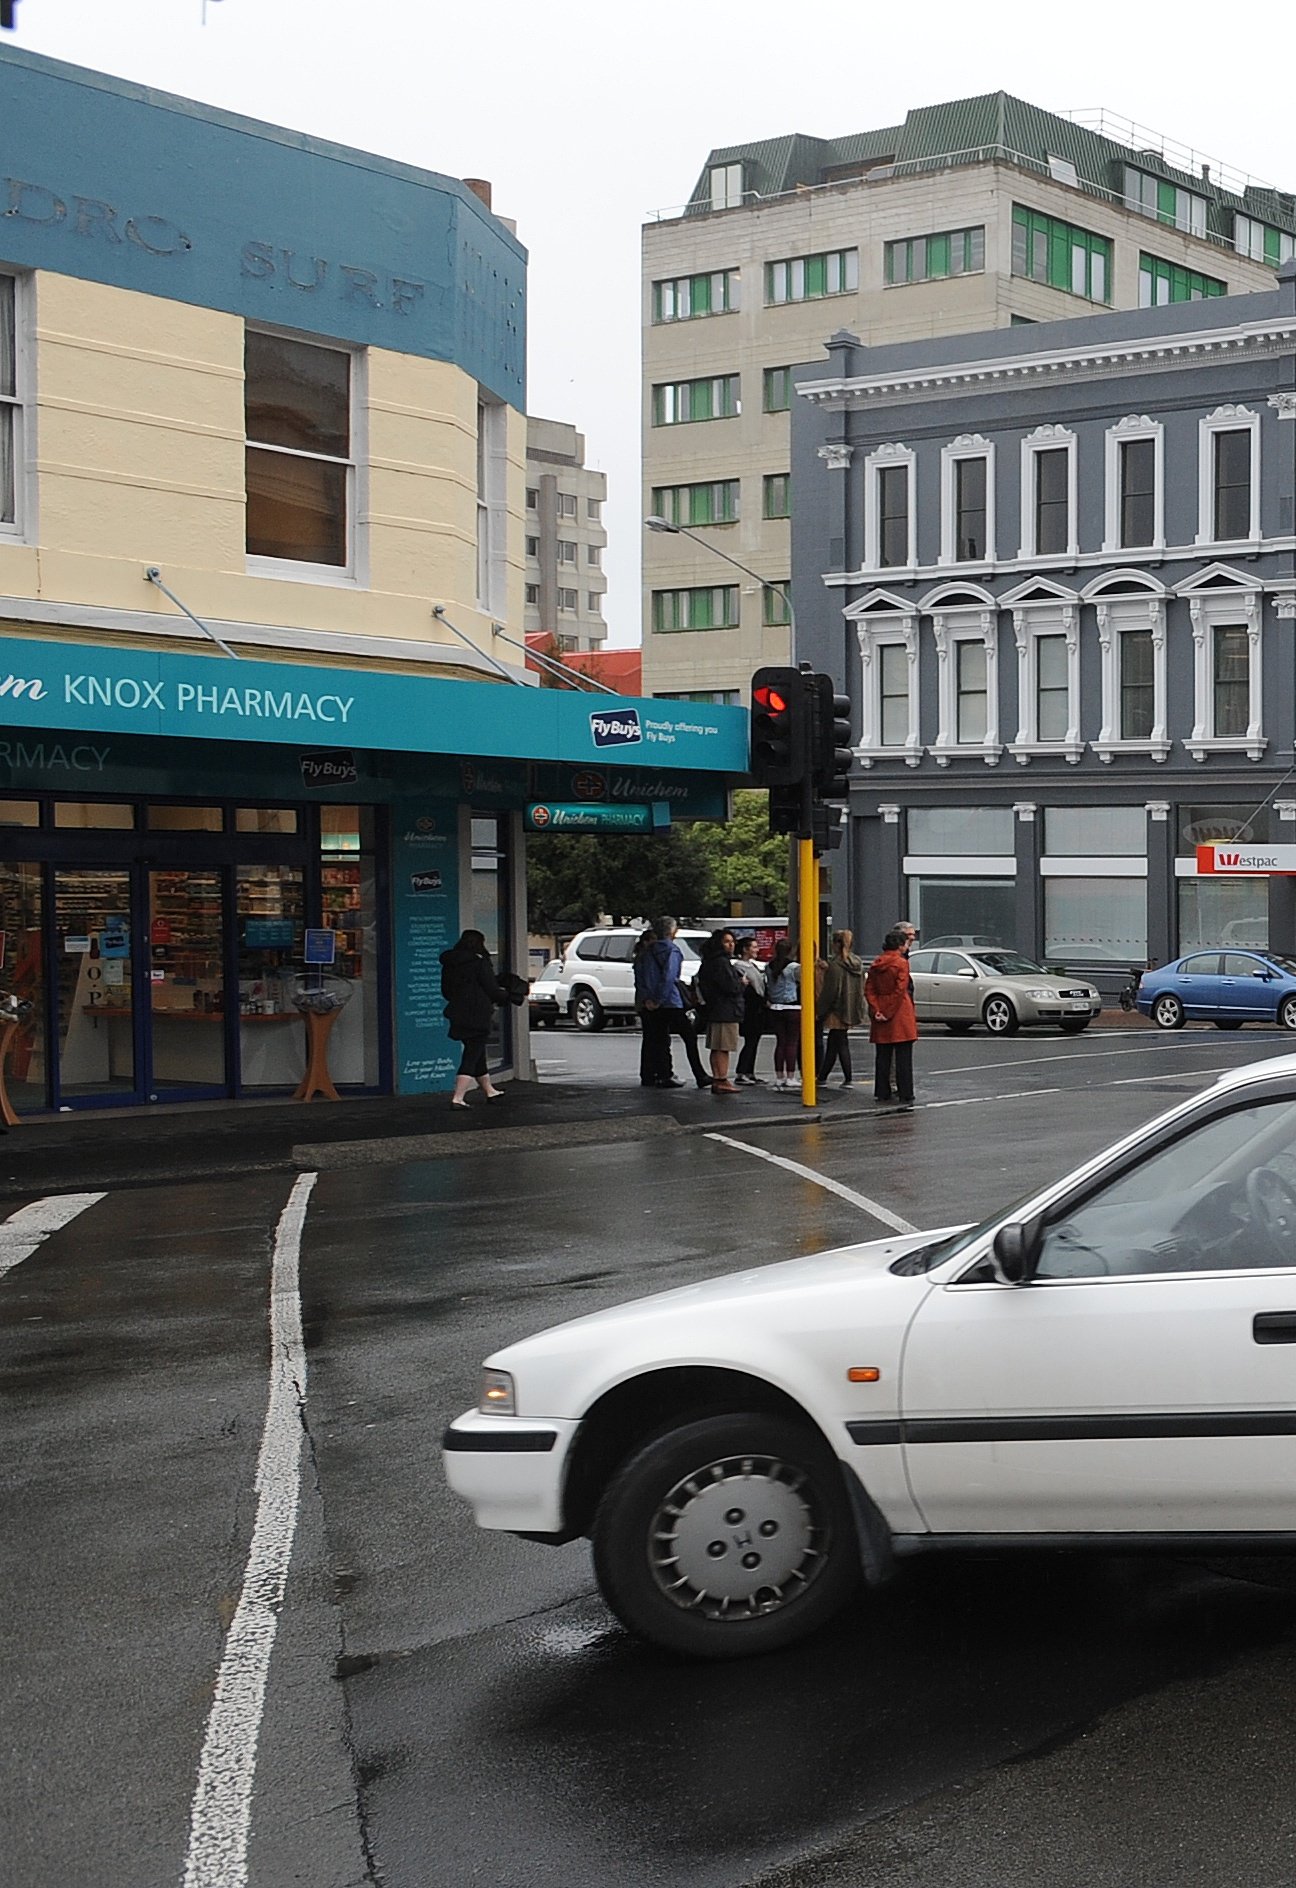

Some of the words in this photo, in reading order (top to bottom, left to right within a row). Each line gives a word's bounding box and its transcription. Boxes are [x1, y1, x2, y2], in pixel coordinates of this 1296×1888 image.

[240, 241, 424, 315] SURF
[64, 673, 165, 710] KNOX
[178, 682, 355, 723] PHARMACY
[645, 720, 674, 733] Proudly
[675, 722, 704, 735] offering
[705, 727, 719, 735] you
[646, 732, 657, 742] Fly
[659, 733, 676, 743] Buys
[611, 777, 689, 798] Unichem
[552, 808, 598, 826] Unichem
[600, 812, 646, 827] PHARMACY
[1219, 853, 1278, 868] Westpac
